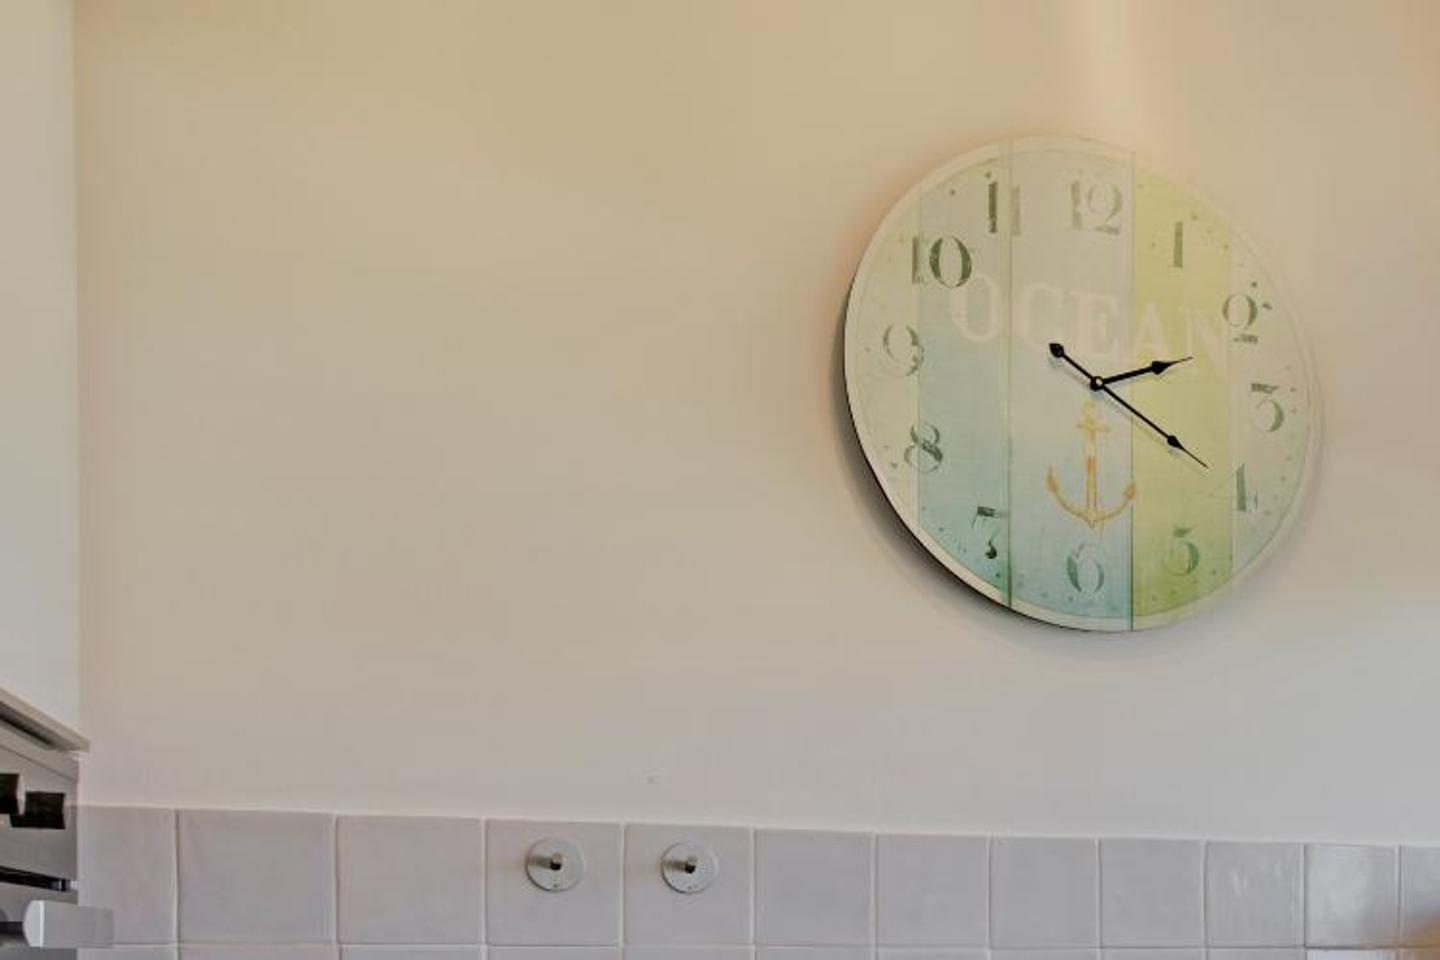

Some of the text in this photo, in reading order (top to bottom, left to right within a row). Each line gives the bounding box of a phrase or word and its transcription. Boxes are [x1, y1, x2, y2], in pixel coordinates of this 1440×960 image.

[986, 180, 1023, 237] 11
[1068, 180, 1124, 235] 12
[910, 234, 973, 289] 10
[1171, 221, 1185, 268] 1
[882, 323, 925, 377] 9
[949, 275, 1229, 371] OCEAN
[1249, 382, 1286, 433] 3
[903, 421, 945, 474] 8
[971, 505, 1007, 560] 7
[1163, 525, 1200, 577] 5
[1065, 541, 1105, 595] 6
